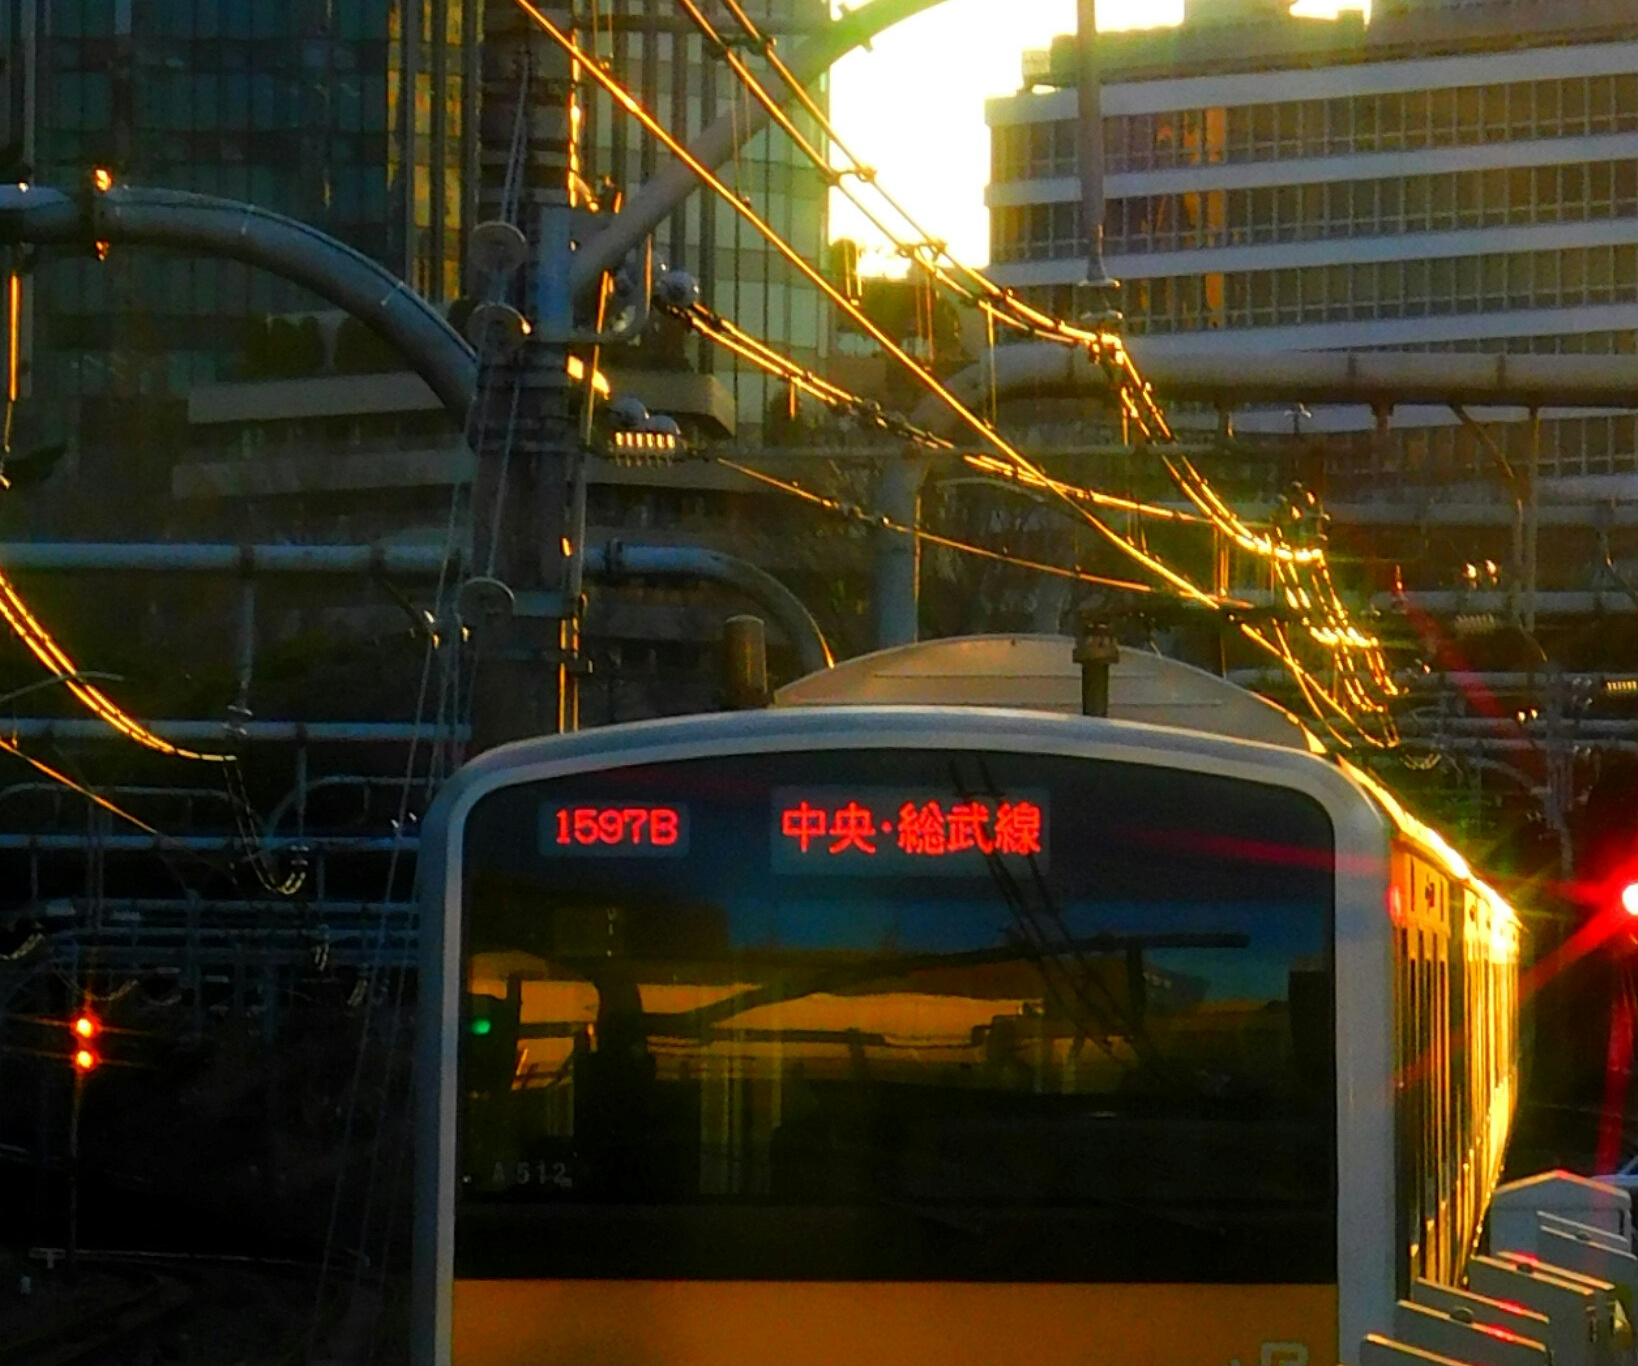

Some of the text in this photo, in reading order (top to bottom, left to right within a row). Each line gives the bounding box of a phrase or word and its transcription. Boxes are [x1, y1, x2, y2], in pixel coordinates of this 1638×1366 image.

[555, 808, 679, 845] 1597B
[781, 800, 1041, 855] 中央・総武線
